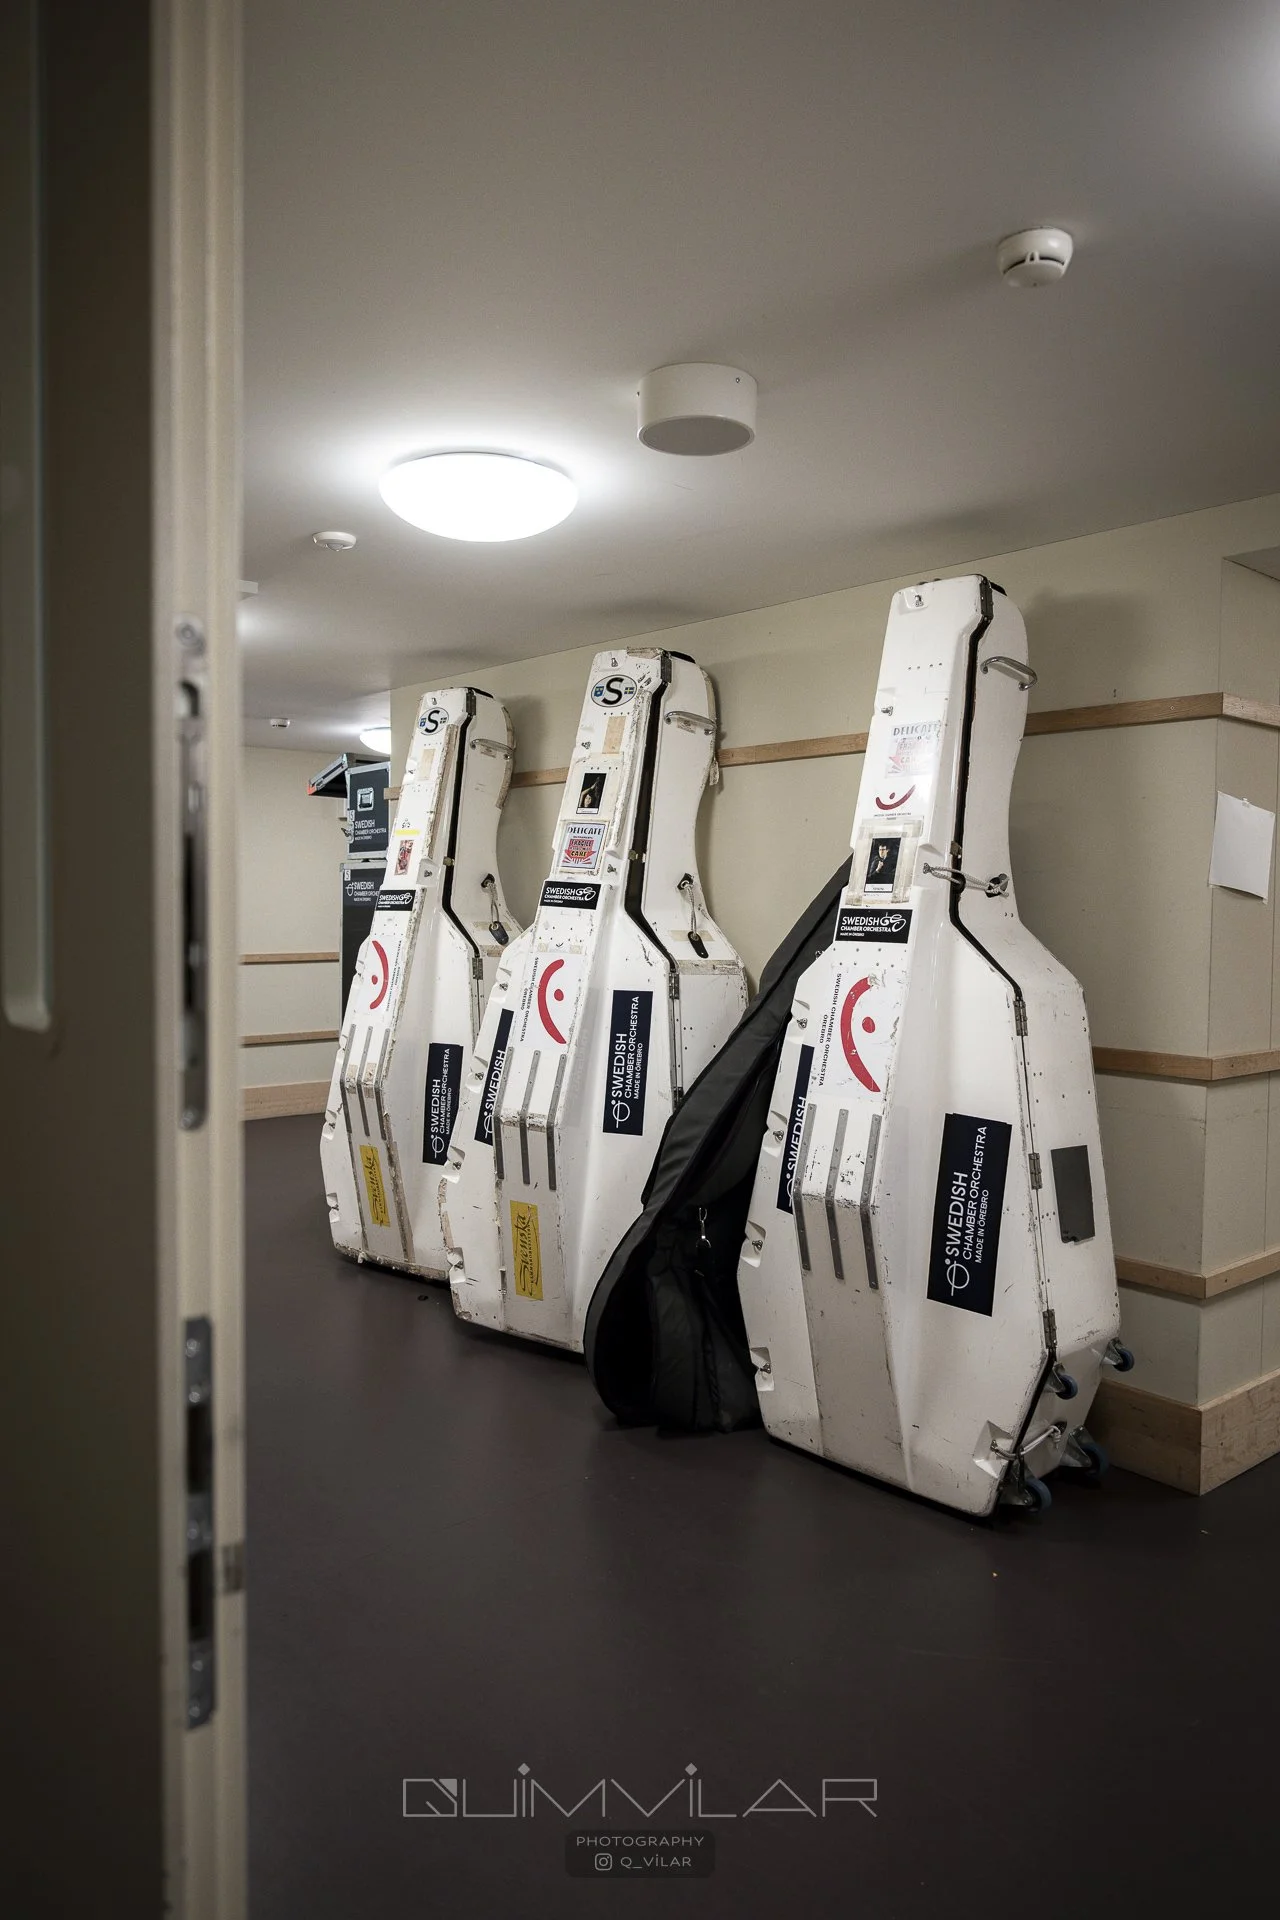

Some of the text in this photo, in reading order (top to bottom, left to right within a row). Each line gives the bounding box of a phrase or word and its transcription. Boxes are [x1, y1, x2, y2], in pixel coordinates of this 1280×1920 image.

[601, 677, 624, 705] S
[425, 710, 440, 733] S
[355, 820, 375, 829] SWEDISH
[354, 882, 374, 890] SWEDISH
[545, 887, 575, 895] SWEDISH
[842, 916, 879, 926] SWEDISH
[520, 1010, 530, 1042] ORCHESTRA
[625, 996, 639, 1099] CHAMBER ORCHESTRA
[819, 973, 842, 1086] SWEDISH CHAMBER ORCHESTRA
[441, 1048, 450, 1095] ORCHESTRA
[485, 1050, 506, 1110] SWEDISH
[612, 1033, 627, 1098] SWEDISH
[431, 1079, 440, 1133] SWEDISH
[787, 1096, 806, 1171] SWEDISH
[946, 1171, 968, 1257] SWEDISH
[962, 1126, 987, 1260] CHAMBER ORCHESTRA
[975, 1189, 989, 1263] MADE IN ÖREBRO
